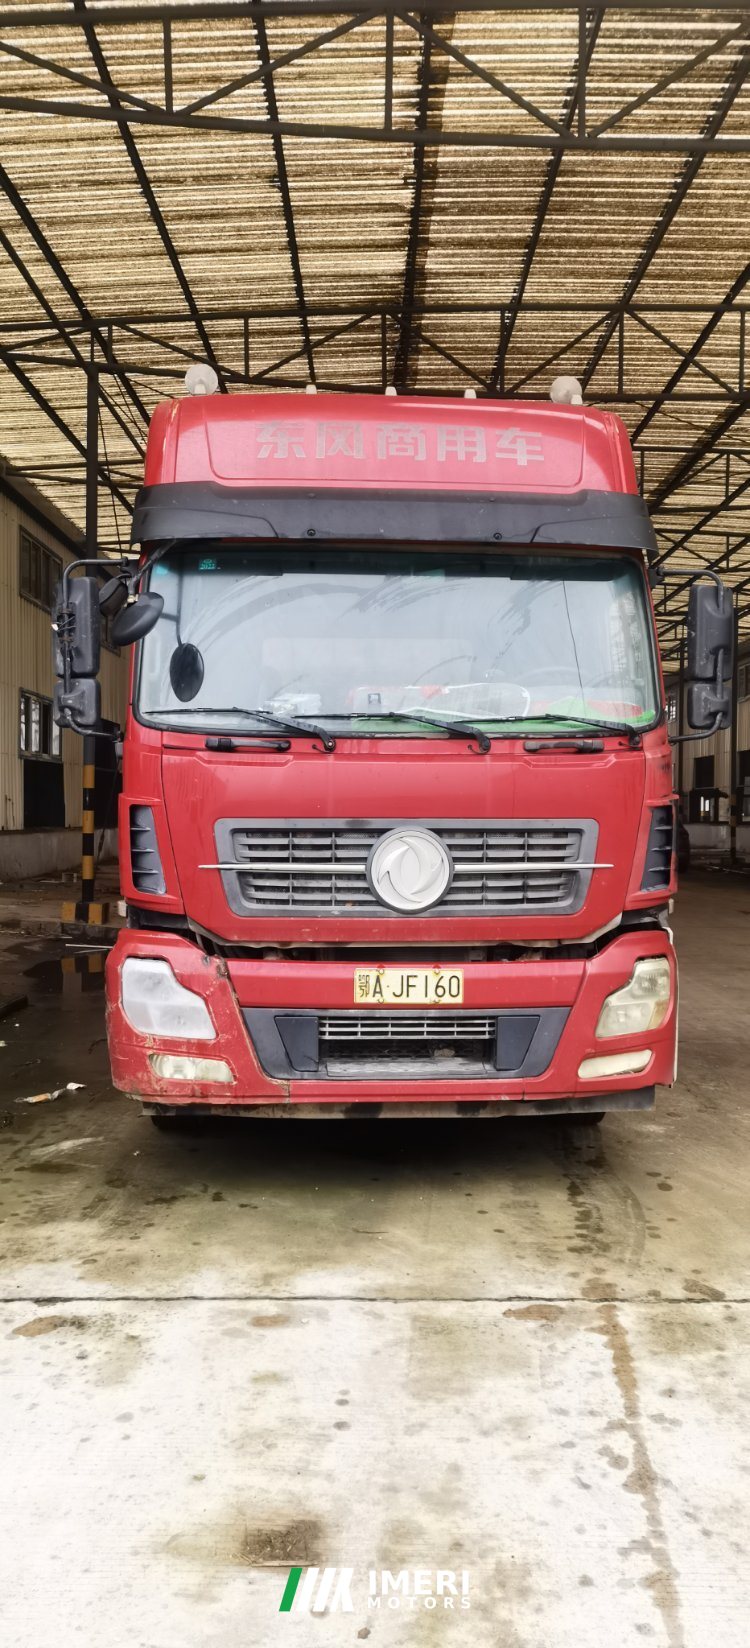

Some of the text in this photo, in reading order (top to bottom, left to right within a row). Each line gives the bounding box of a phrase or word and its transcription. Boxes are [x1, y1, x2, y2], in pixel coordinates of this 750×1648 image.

[256, 421, 544, 465] 东风商用车
